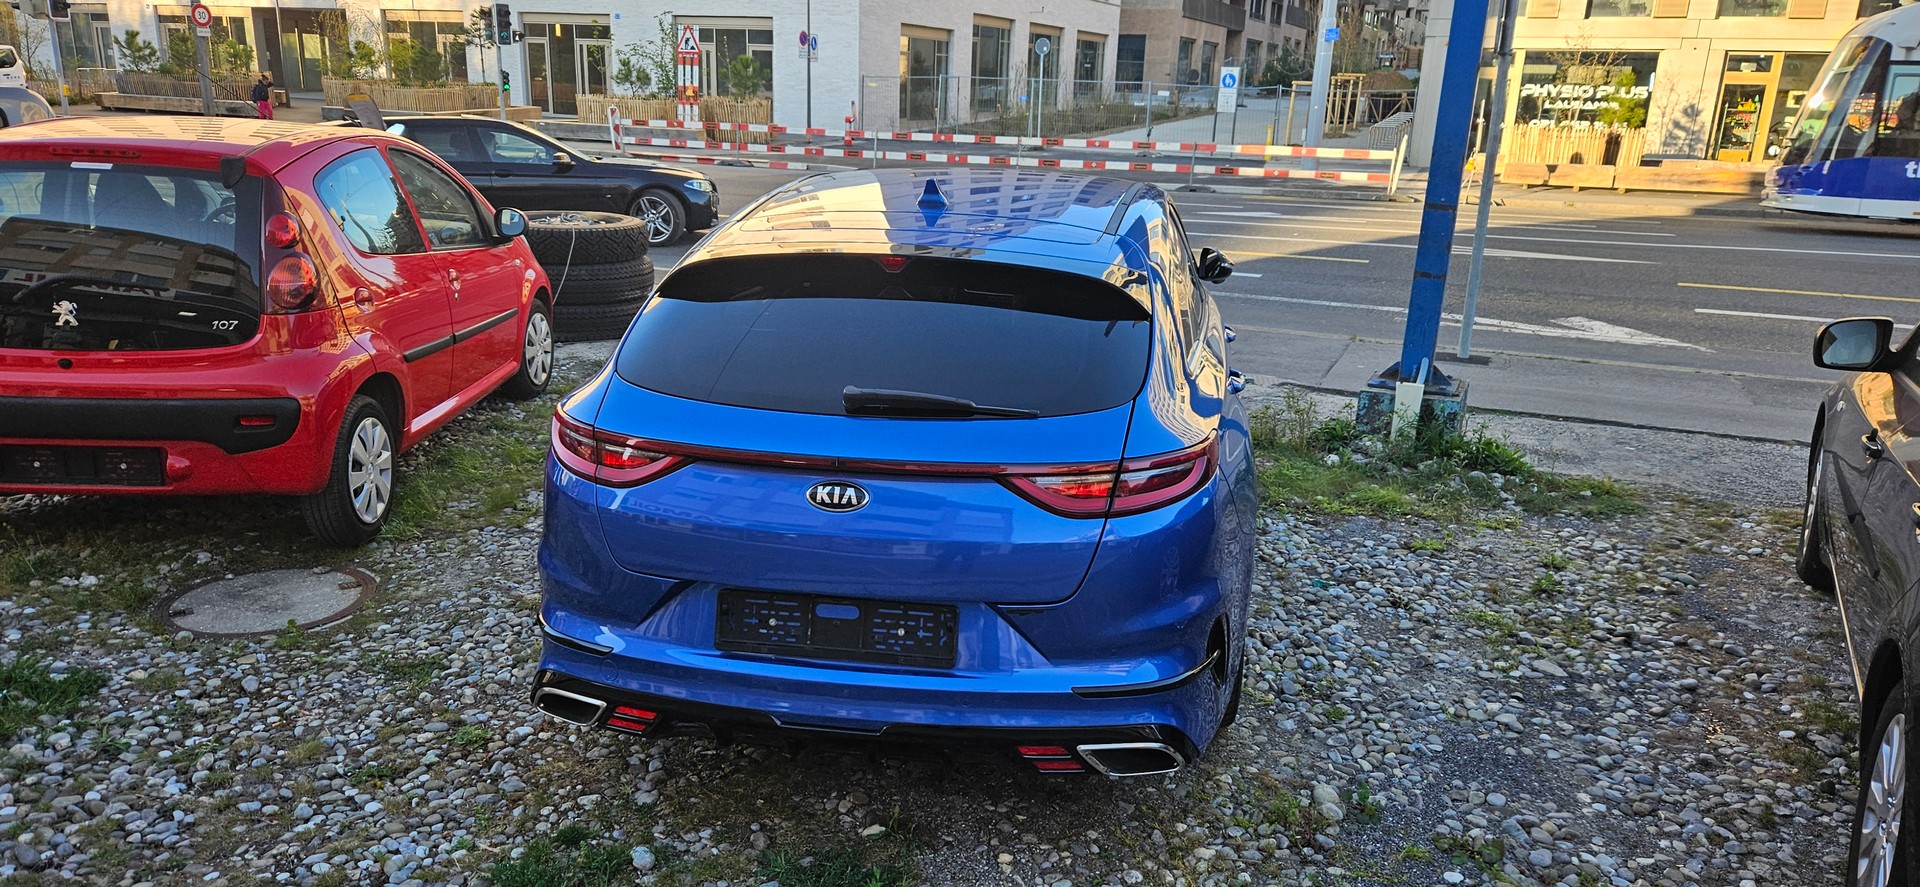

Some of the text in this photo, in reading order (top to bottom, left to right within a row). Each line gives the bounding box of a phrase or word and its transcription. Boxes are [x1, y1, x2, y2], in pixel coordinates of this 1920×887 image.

[197, 11, 206, 20] 30
[1521, 83, 1649, 99] PHYSIO PLUS
[211, 320, 239, 330] 107
[816, 485, 858, 505] KIA
